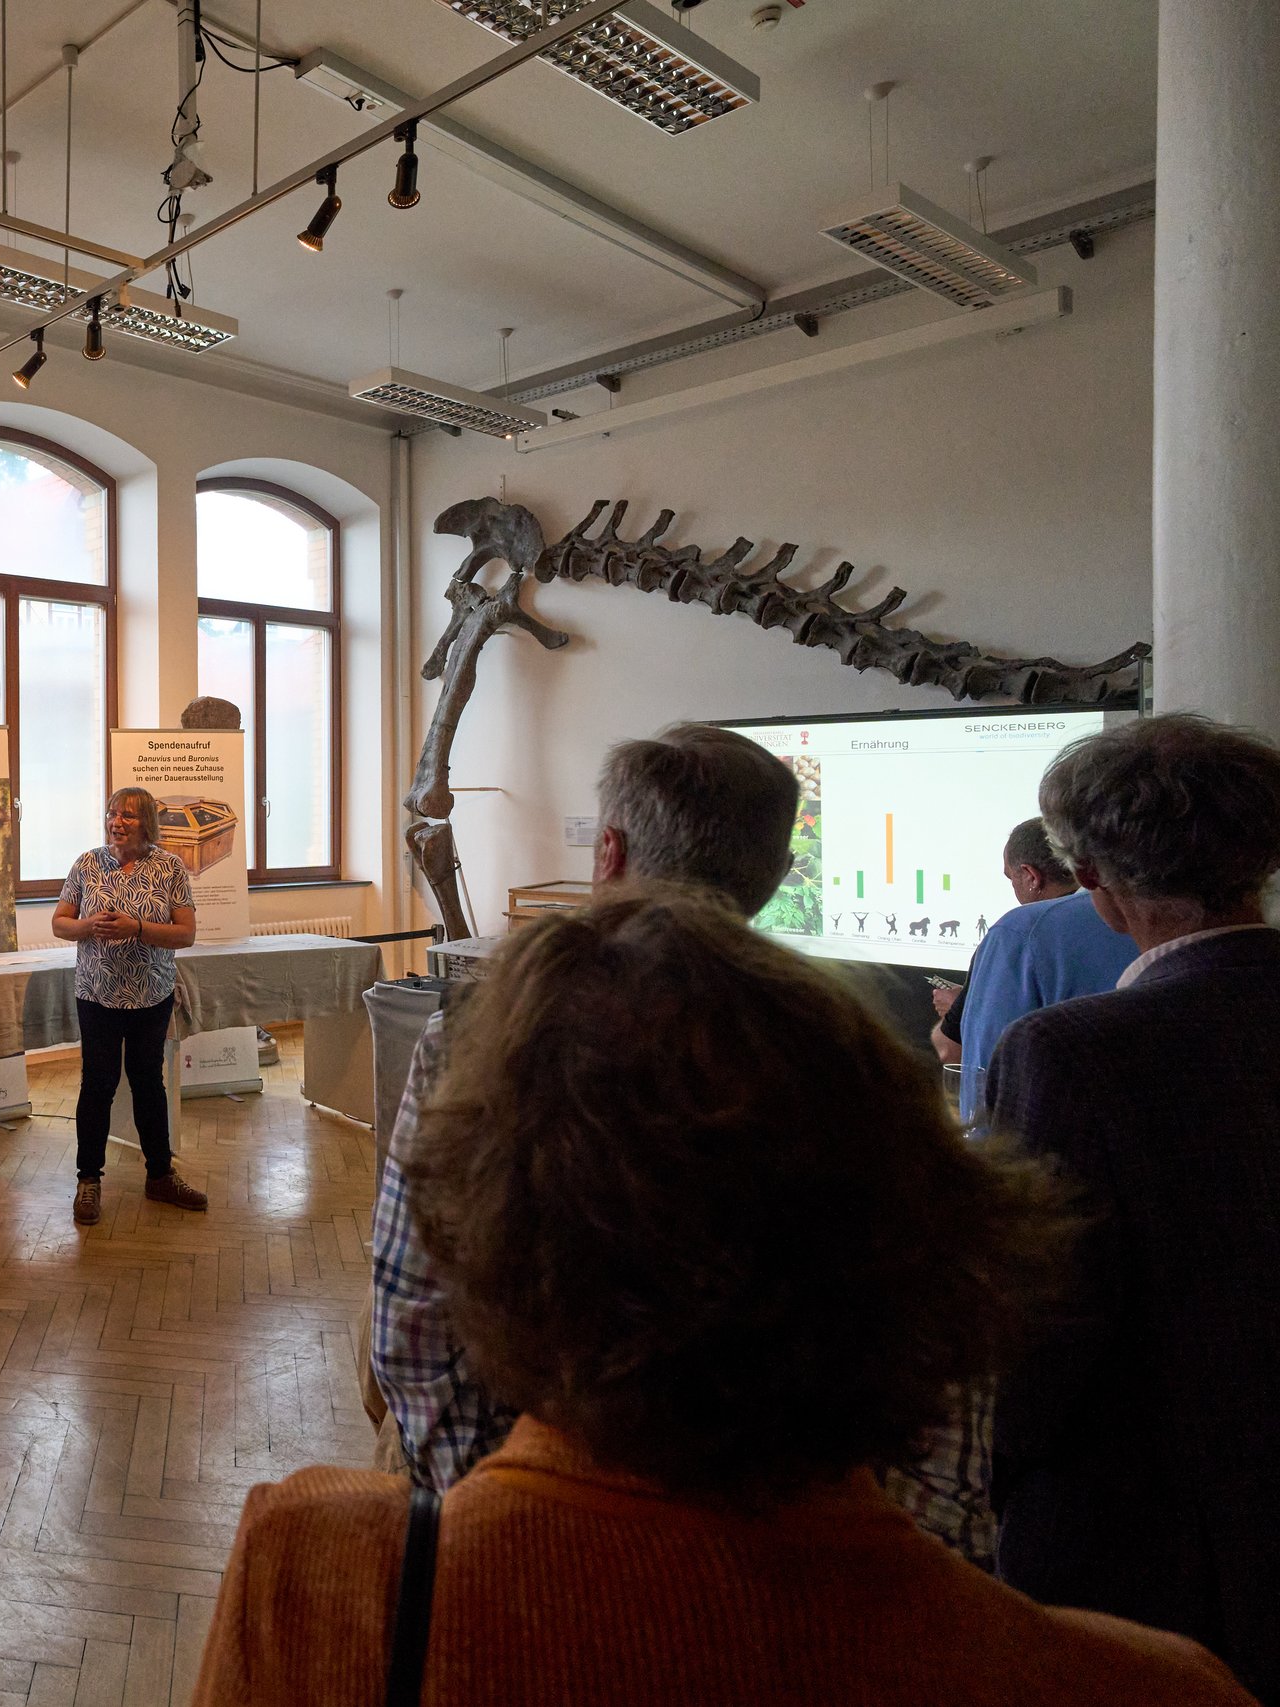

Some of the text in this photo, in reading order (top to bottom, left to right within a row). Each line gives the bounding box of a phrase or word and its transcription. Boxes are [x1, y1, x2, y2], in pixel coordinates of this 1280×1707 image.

[964, 721, 1066, 733] SENCKENBERG
[147, 740, 211, 751] Spendenaufruf
[851, 739, 909, 750] Ernährung
[195, 764, 224, 772] Zuhause
[164, 774, 224, 783] Dauerausstellung
